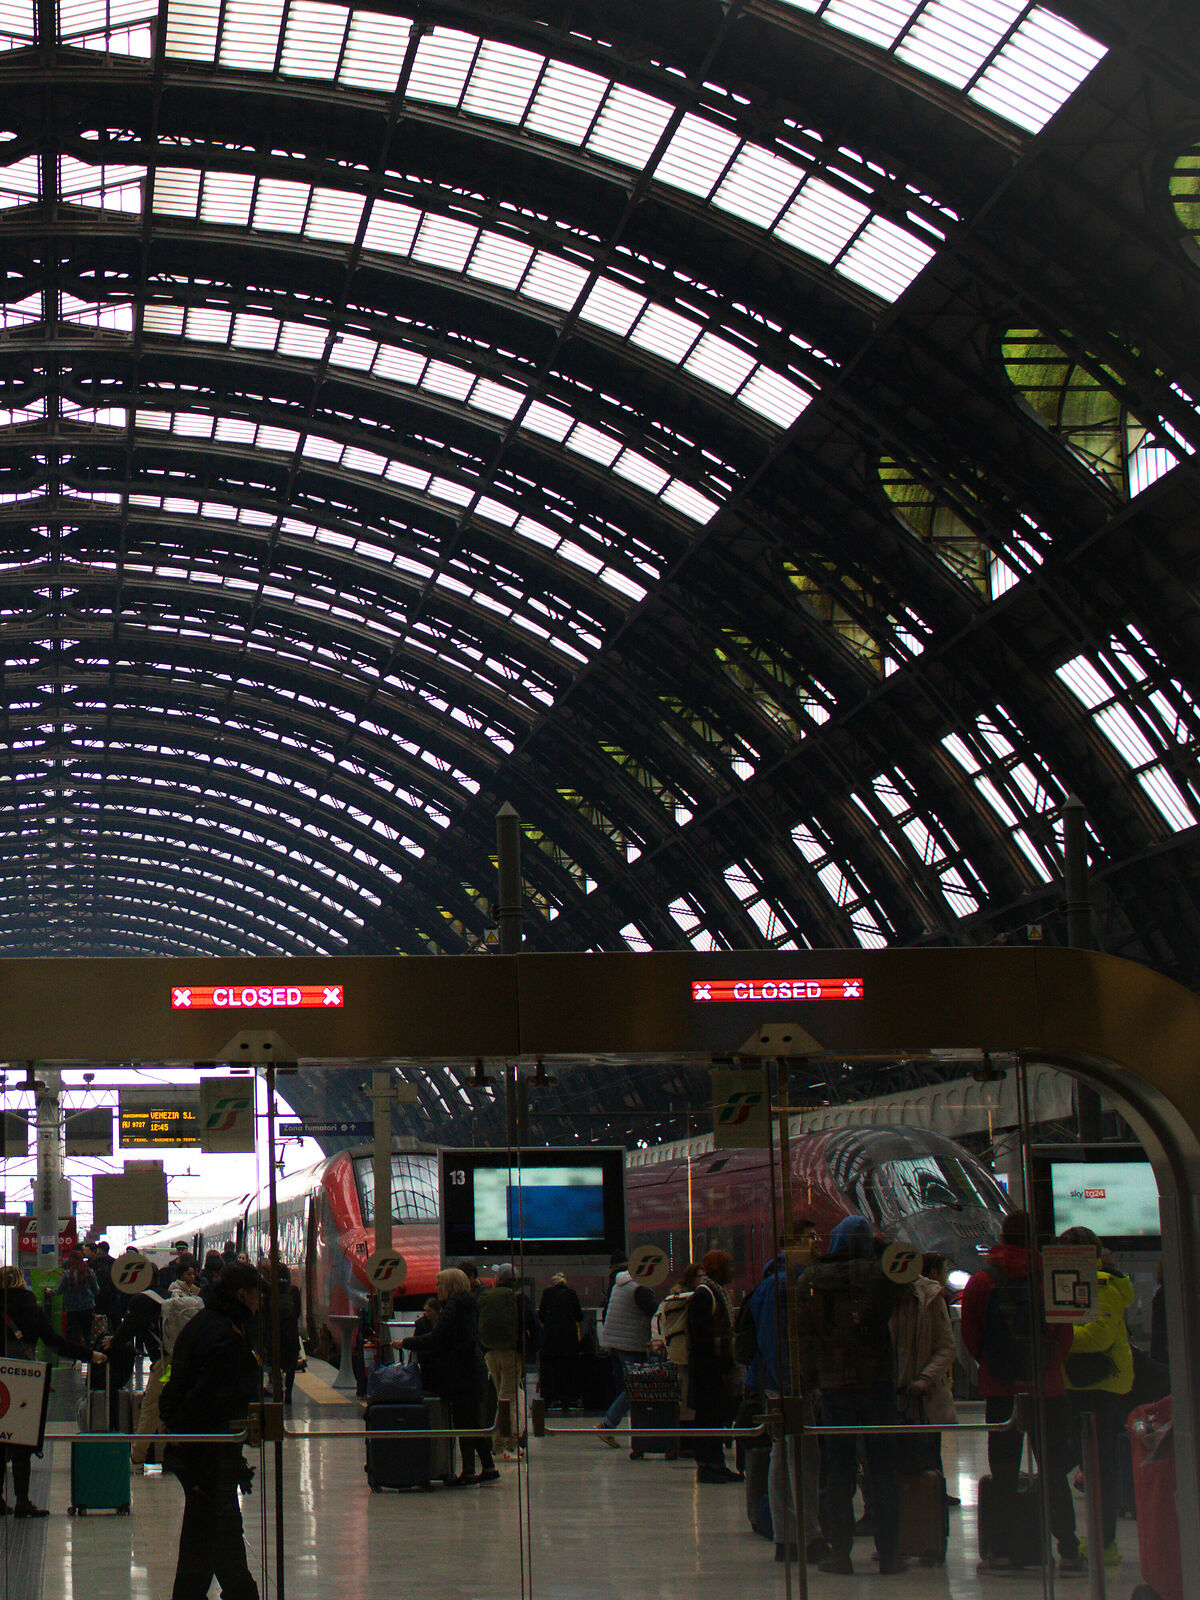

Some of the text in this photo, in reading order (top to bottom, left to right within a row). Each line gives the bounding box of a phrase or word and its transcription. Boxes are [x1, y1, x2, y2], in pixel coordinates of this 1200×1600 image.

[734, 982, 822, 999] CLOSED
[213, 988, 302, 1006] CLOSED
[150, 1111, 180, 1119] VENEZIA
[183, 1111, 196, 1120] S.L.
[150, 1123, 169, 1131] 12:45
[283, 1123, 337, 1132] Zona fumatori
[450, 1170, 466, 1185] 13
[1070, 1190, 1105, 1199] sky tg24
